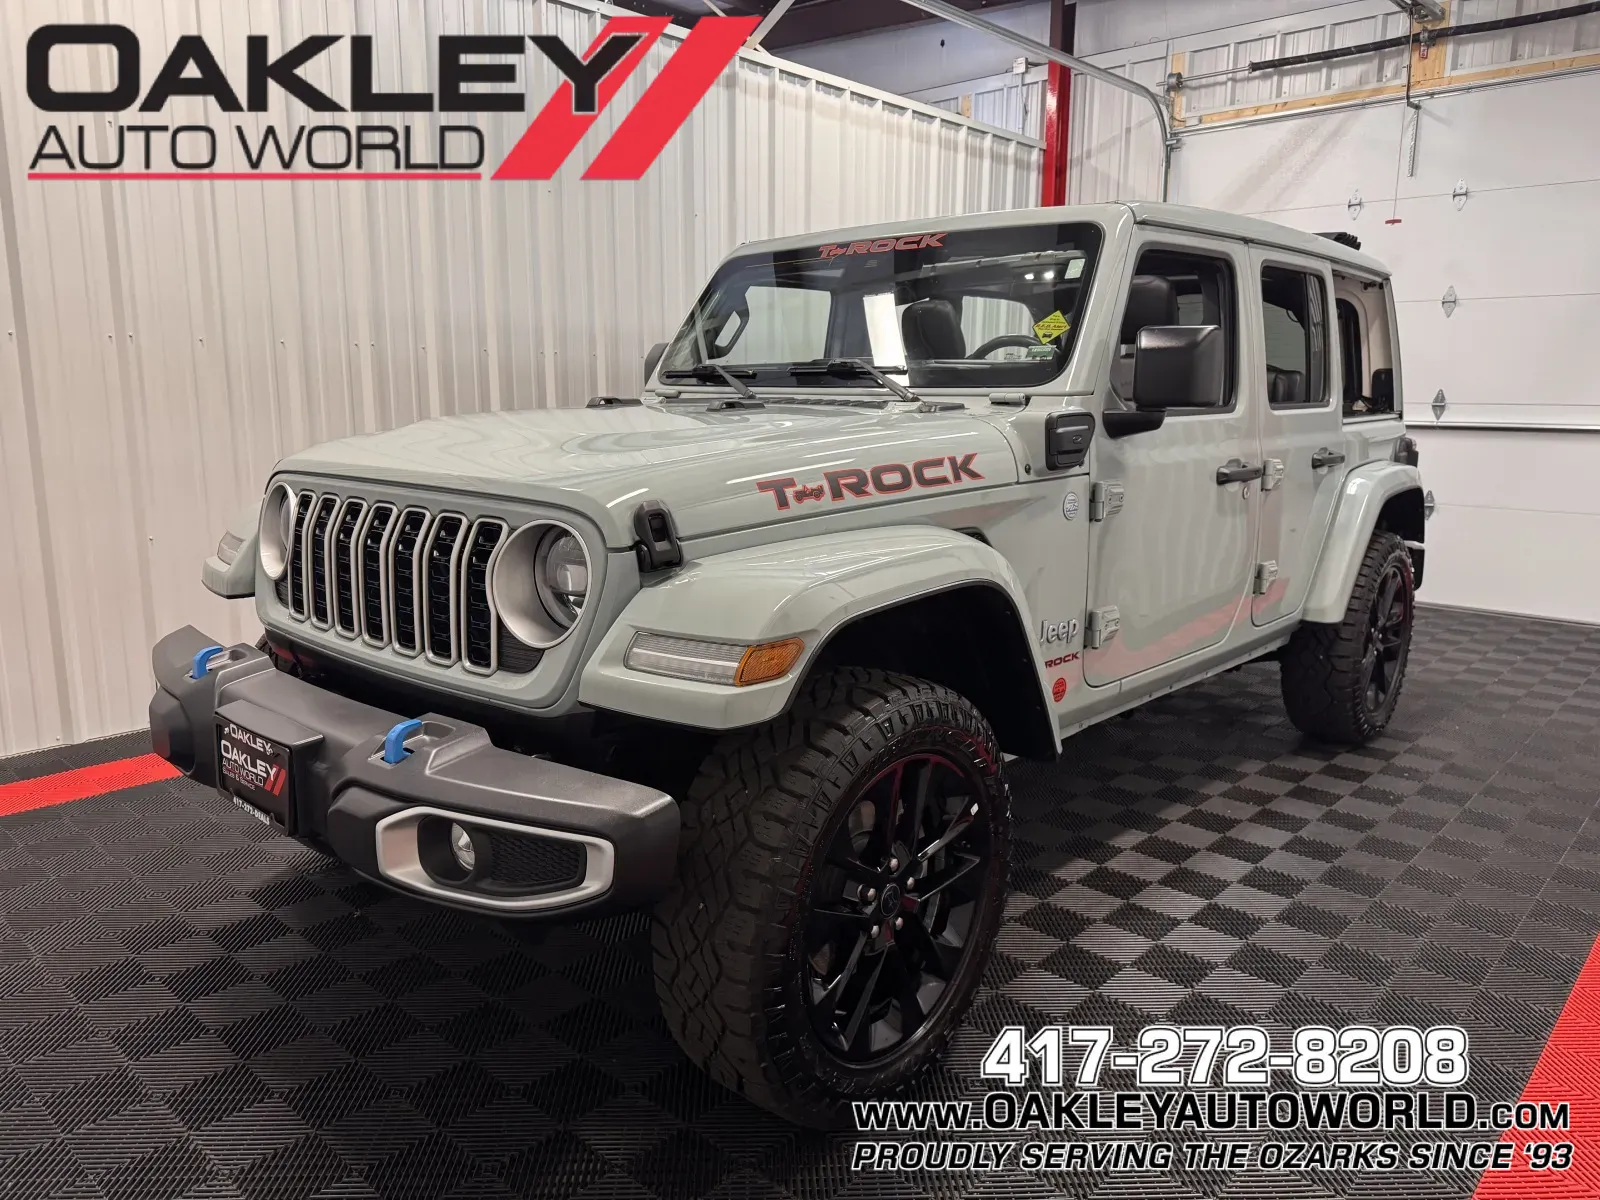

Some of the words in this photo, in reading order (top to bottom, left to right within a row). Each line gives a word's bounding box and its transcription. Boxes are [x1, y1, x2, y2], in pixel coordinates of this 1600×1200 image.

[1040, 618, 1079, 646] Jeep
[1044, 651, 1080, 669] ROCK
[229, 723, 272, 755] OAKLEY
[220, 739, 277, 781] OAKLEY
[222, 757, 240, 773] AUTO
[239, 766, 264, 786] WORLD
